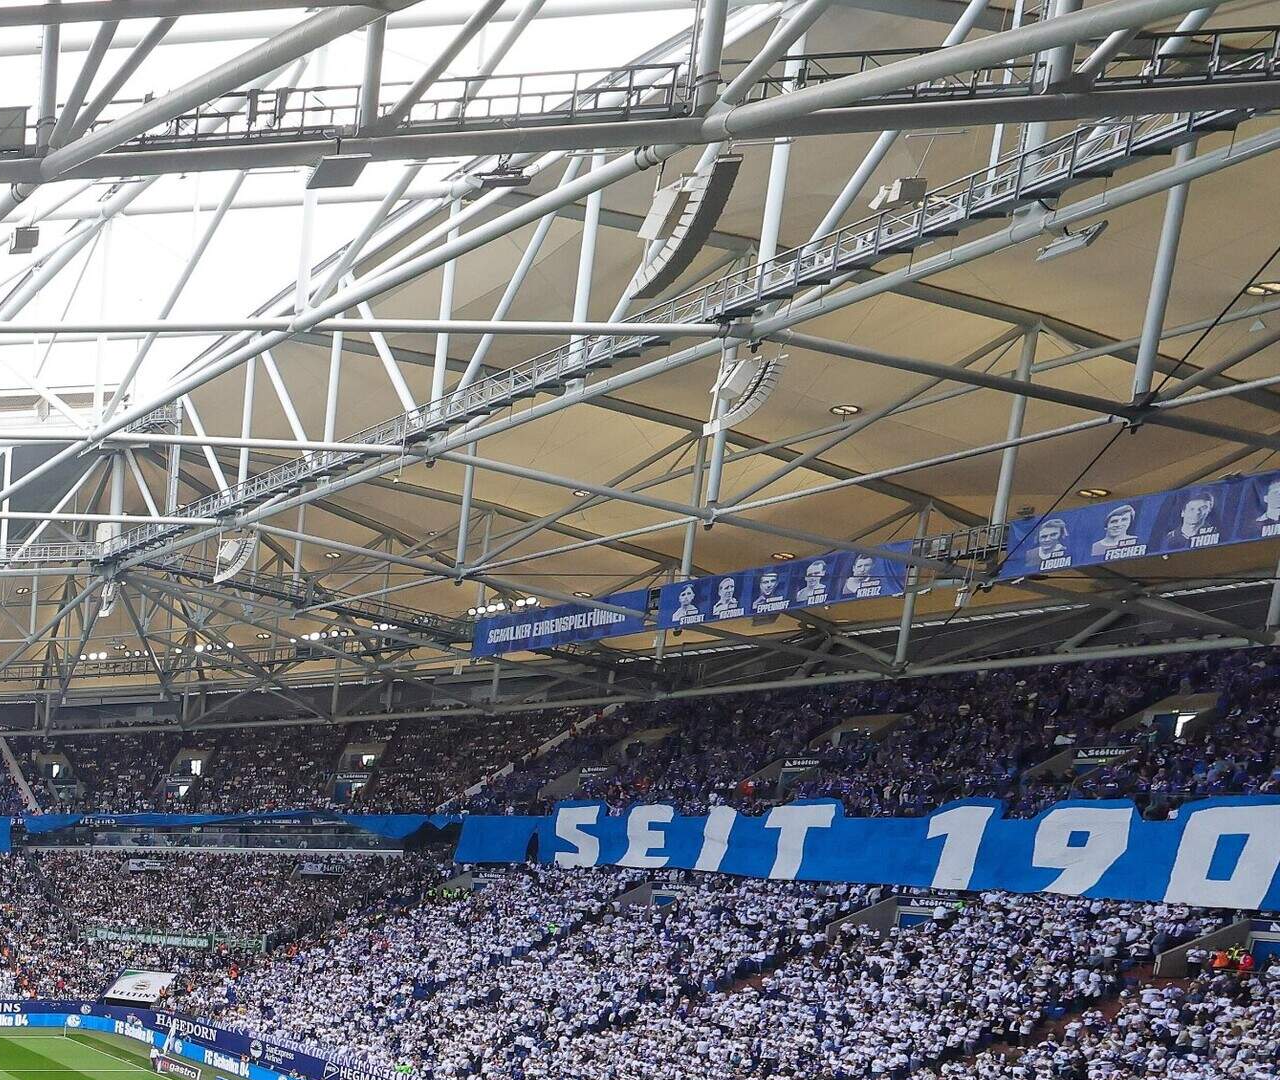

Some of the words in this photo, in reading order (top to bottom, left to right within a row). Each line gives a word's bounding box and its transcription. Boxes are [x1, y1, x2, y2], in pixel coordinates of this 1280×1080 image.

[1190, 533, 1220, 548] THON
[1104, 545, 1147, 560] FISCHER
[1040, 557, 1073, 570] LIBUDA
[857, 586, 881, 598] KREUZ
[554, 804, 836, 880] SEIT
[111, 989, 158, 1000] VELTINS
[15, 1014, 28, 1026] 04
